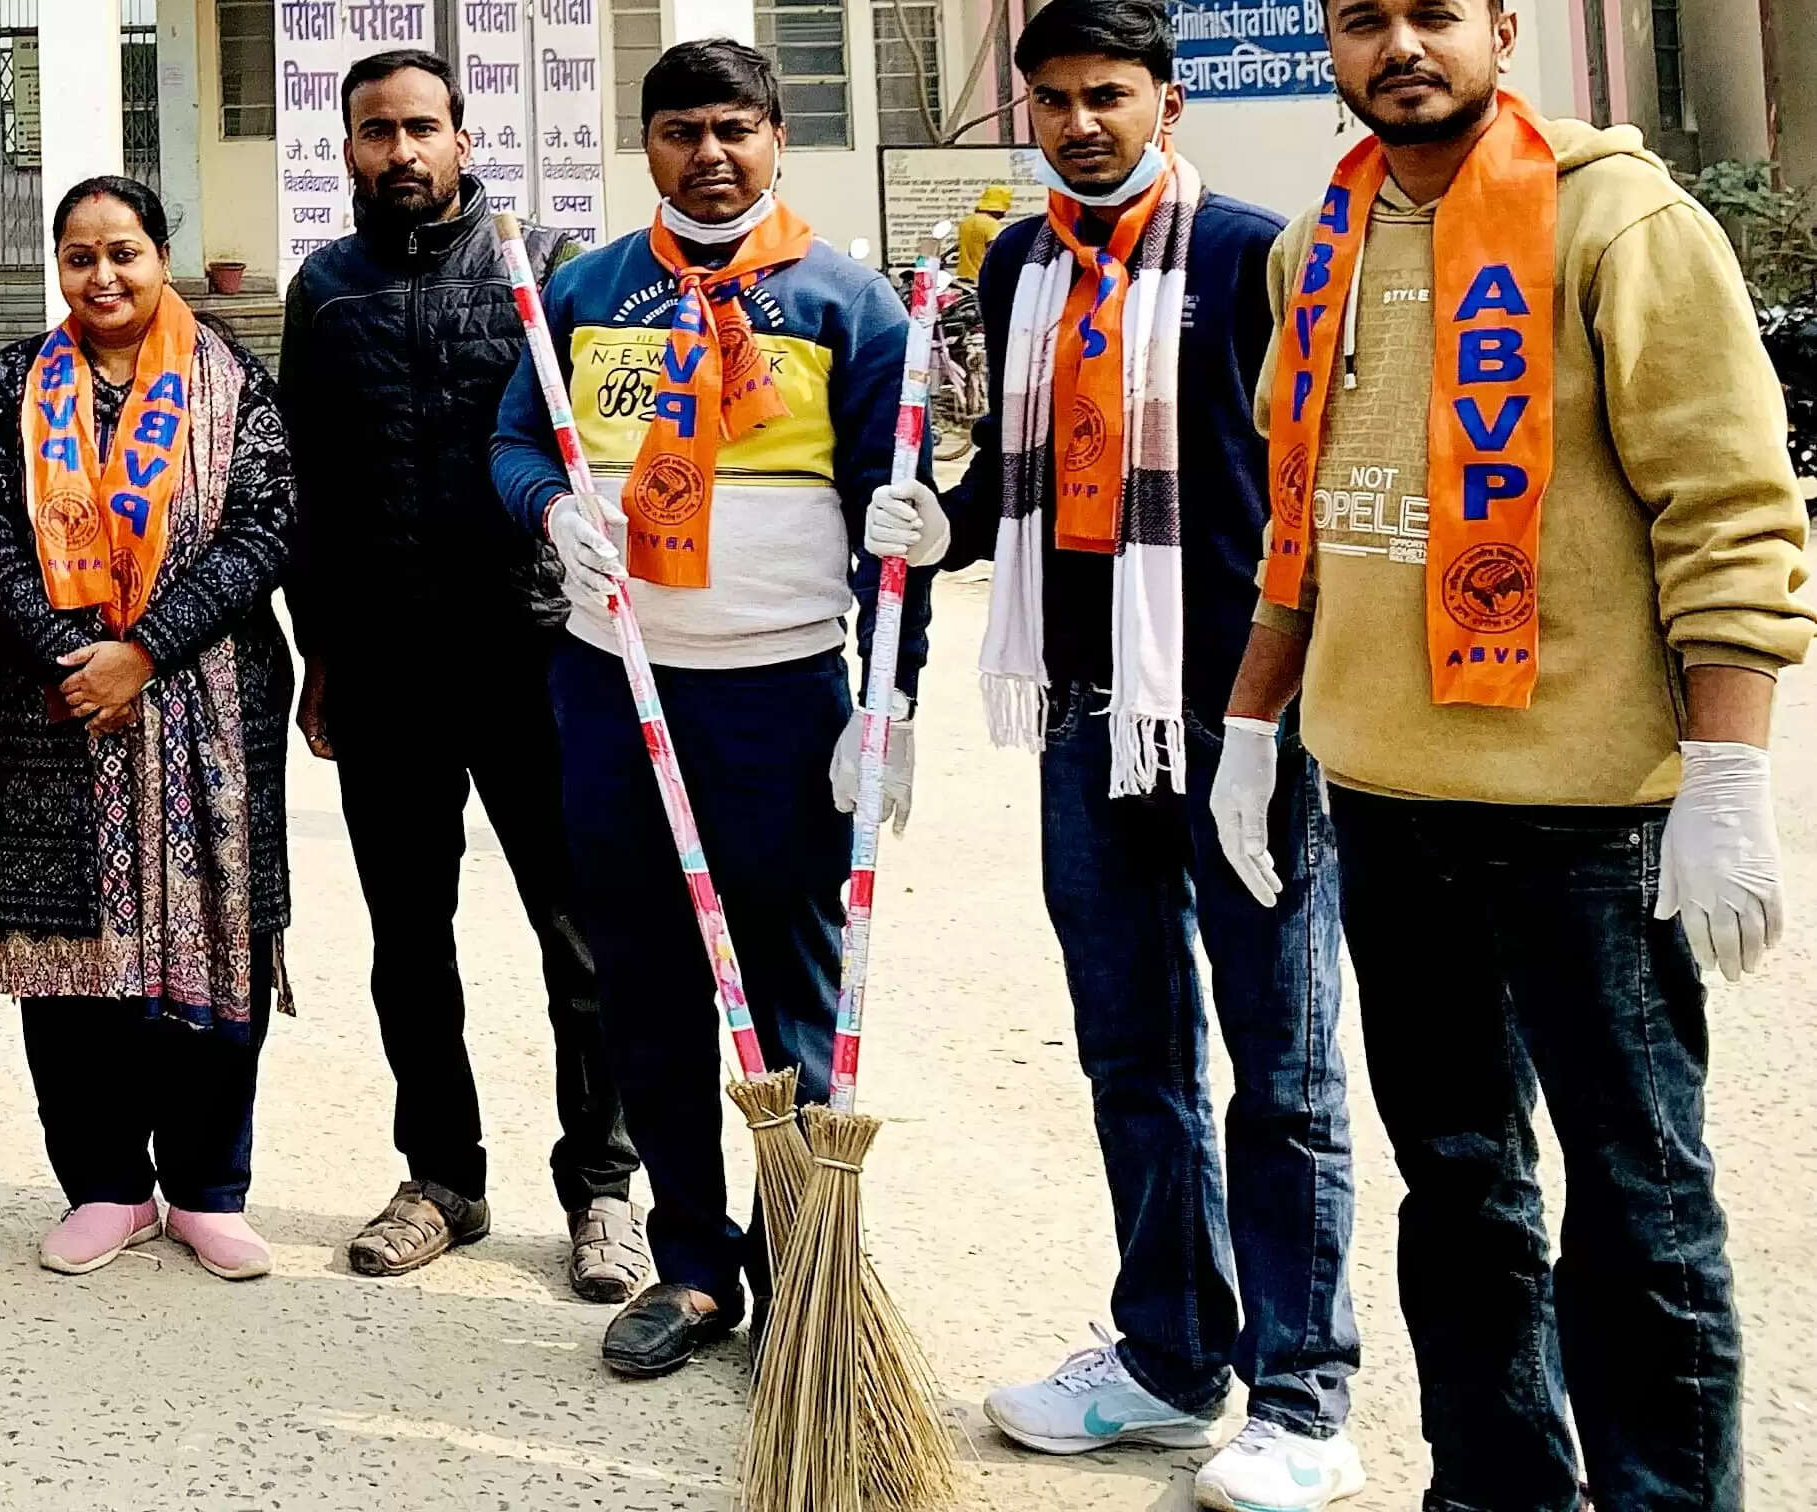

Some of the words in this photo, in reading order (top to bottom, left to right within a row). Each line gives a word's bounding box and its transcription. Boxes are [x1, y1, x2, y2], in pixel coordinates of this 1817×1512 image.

[283, 60, 339, 111] विभाग
[467, 54, 520, 95] विभाग
[542, 48, 596, 92] विभाग
[293, 207, 332, 224] छपरा
[552, 195, 593, 213] छपरा
[613, 280, 664, 322] VINTAGE
[1382, 289, 1430, 304] STYLE
[1453, 263, 1531, 521] ABVP
[1349, 465, 1399, 489] NOT
[1313, 489, 1431, 539] OPELE
[1446, 646, 1530, 667] ABVP
